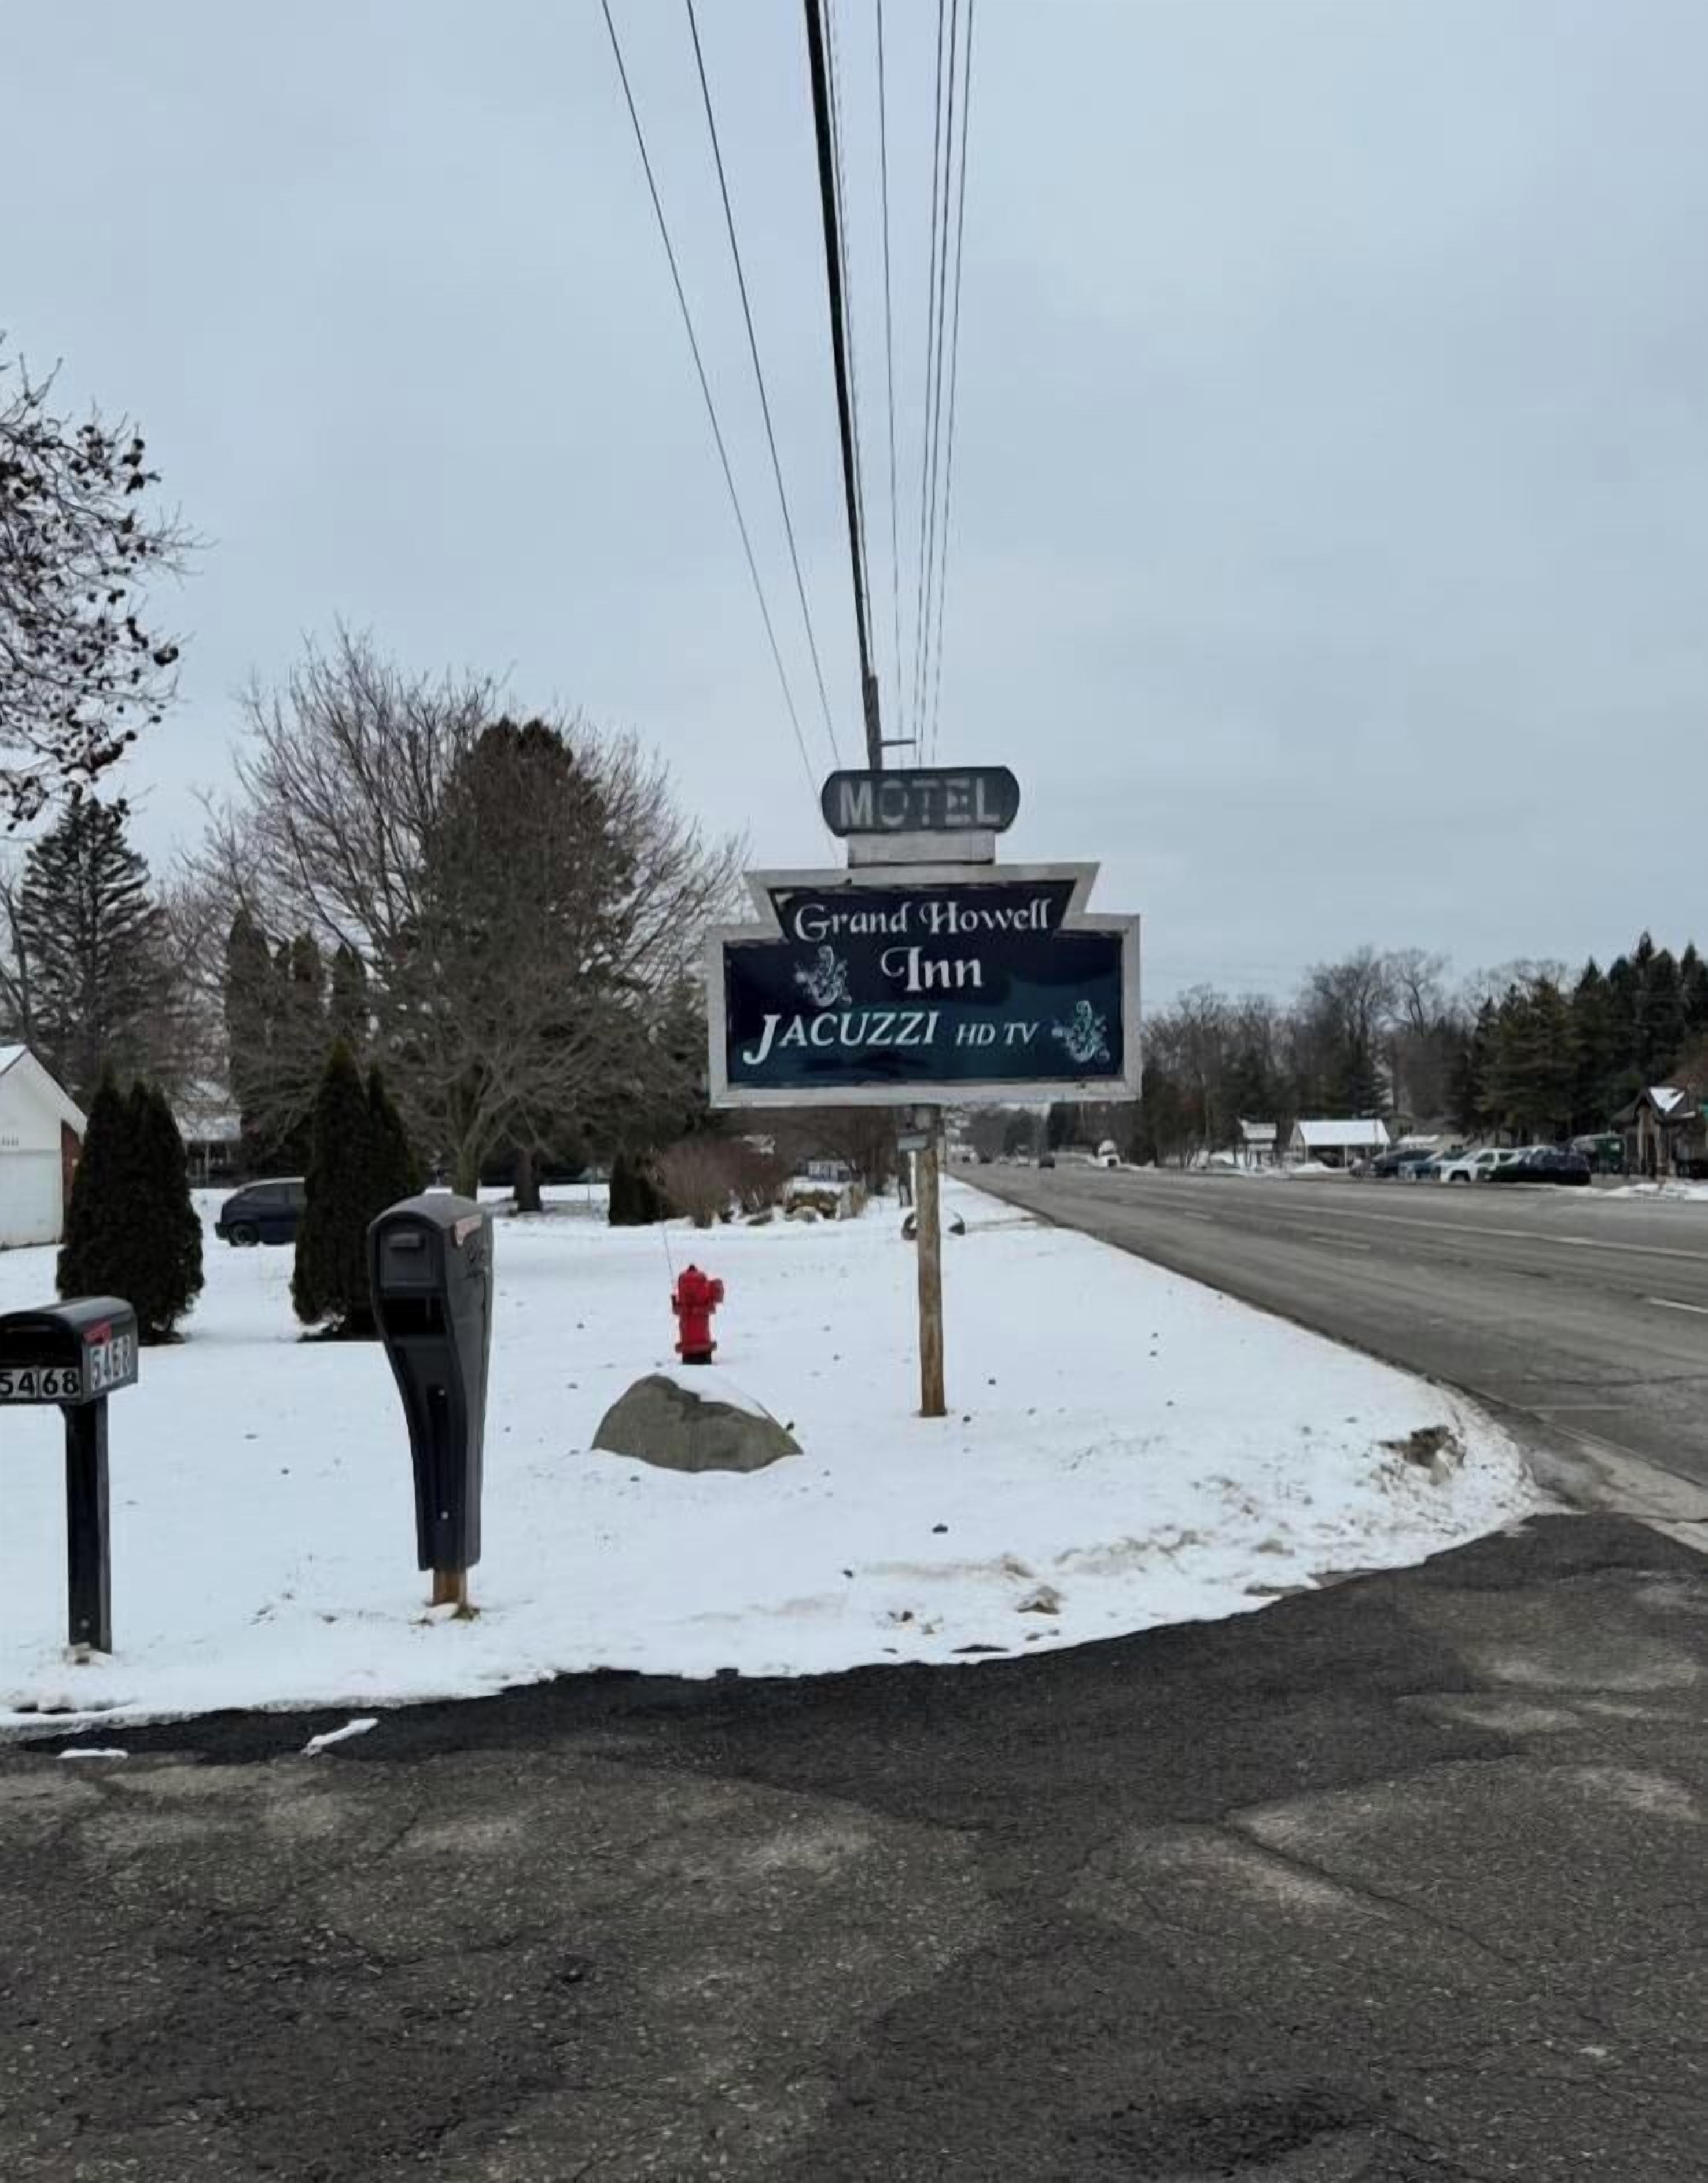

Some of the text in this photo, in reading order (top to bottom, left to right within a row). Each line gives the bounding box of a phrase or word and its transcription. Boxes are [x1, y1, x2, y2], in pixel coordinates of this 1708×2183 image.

[840, 778, 999, 825] MOTEL
[794, 898, 1052, 942] Grand Howell
[881, 946, 983, 991] Inn
[743, 1012, 1037, 1064] JACUZZI HD TV
[0, 1370, 79, 1396] 5468
